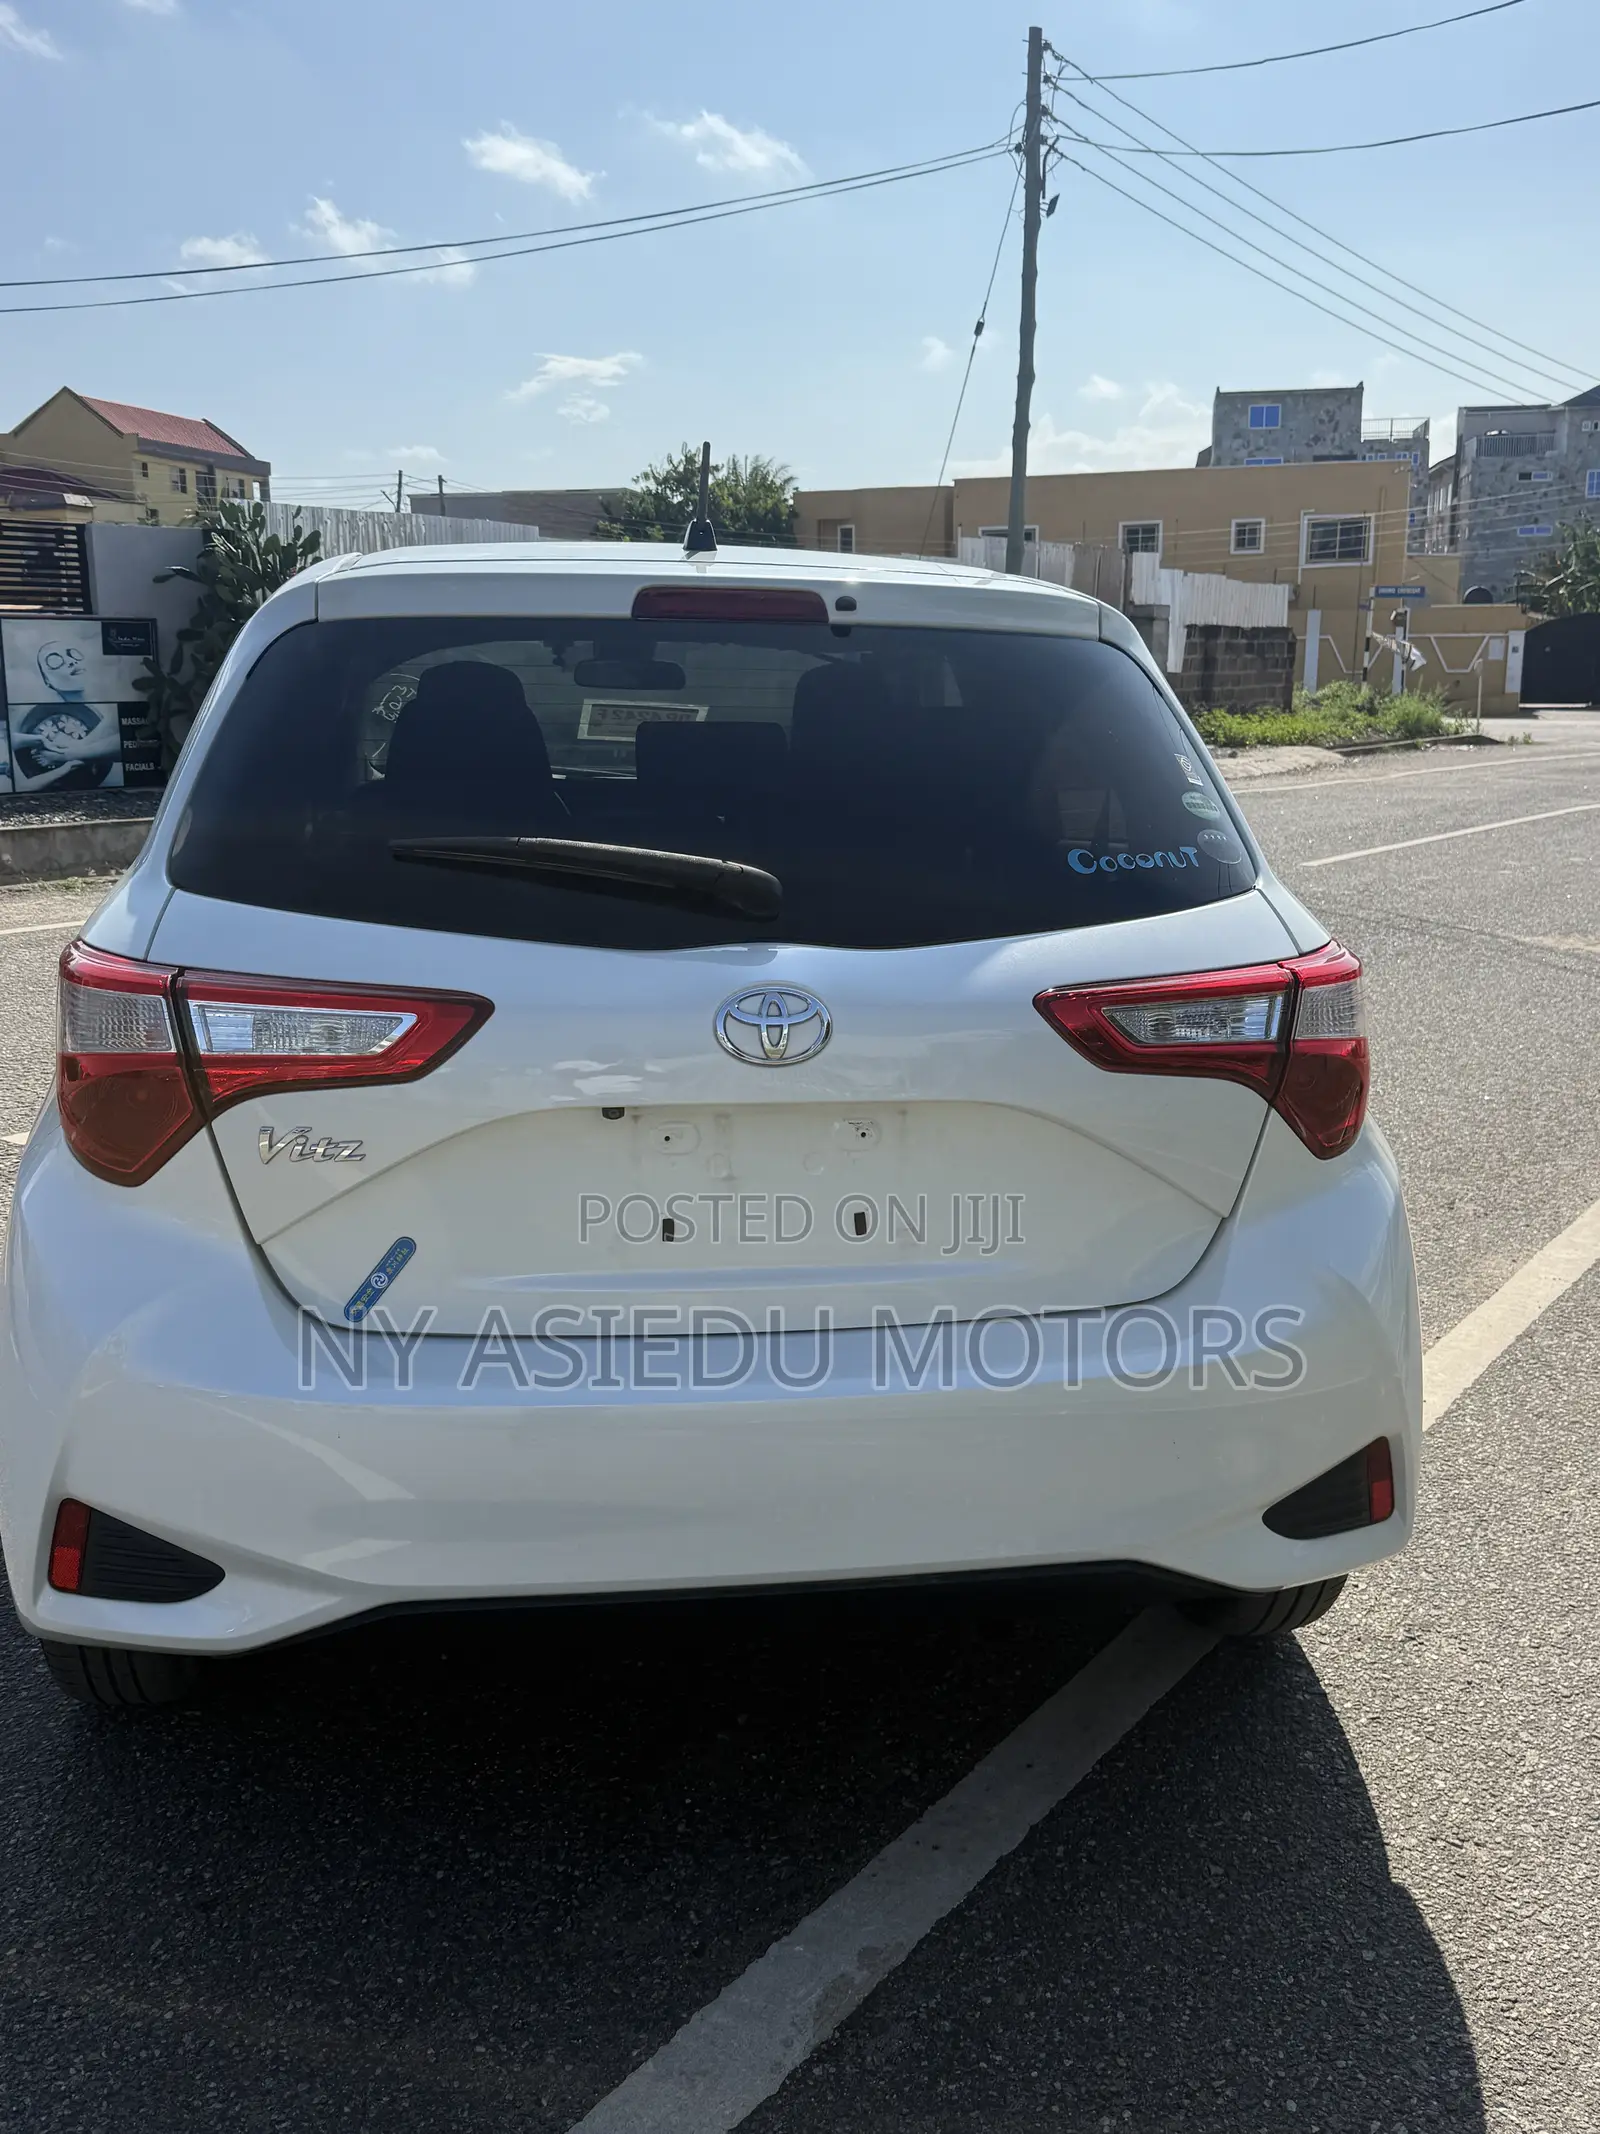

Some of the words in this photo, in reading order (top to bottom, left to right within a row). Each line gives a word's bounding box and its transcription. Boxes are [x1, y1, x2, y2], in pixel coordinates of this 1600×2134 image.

[121, 717, 149, 726] MASSA
[125, 762, 155, 772] FACIALS
[258, 1126, 366, 1165] Vitz
